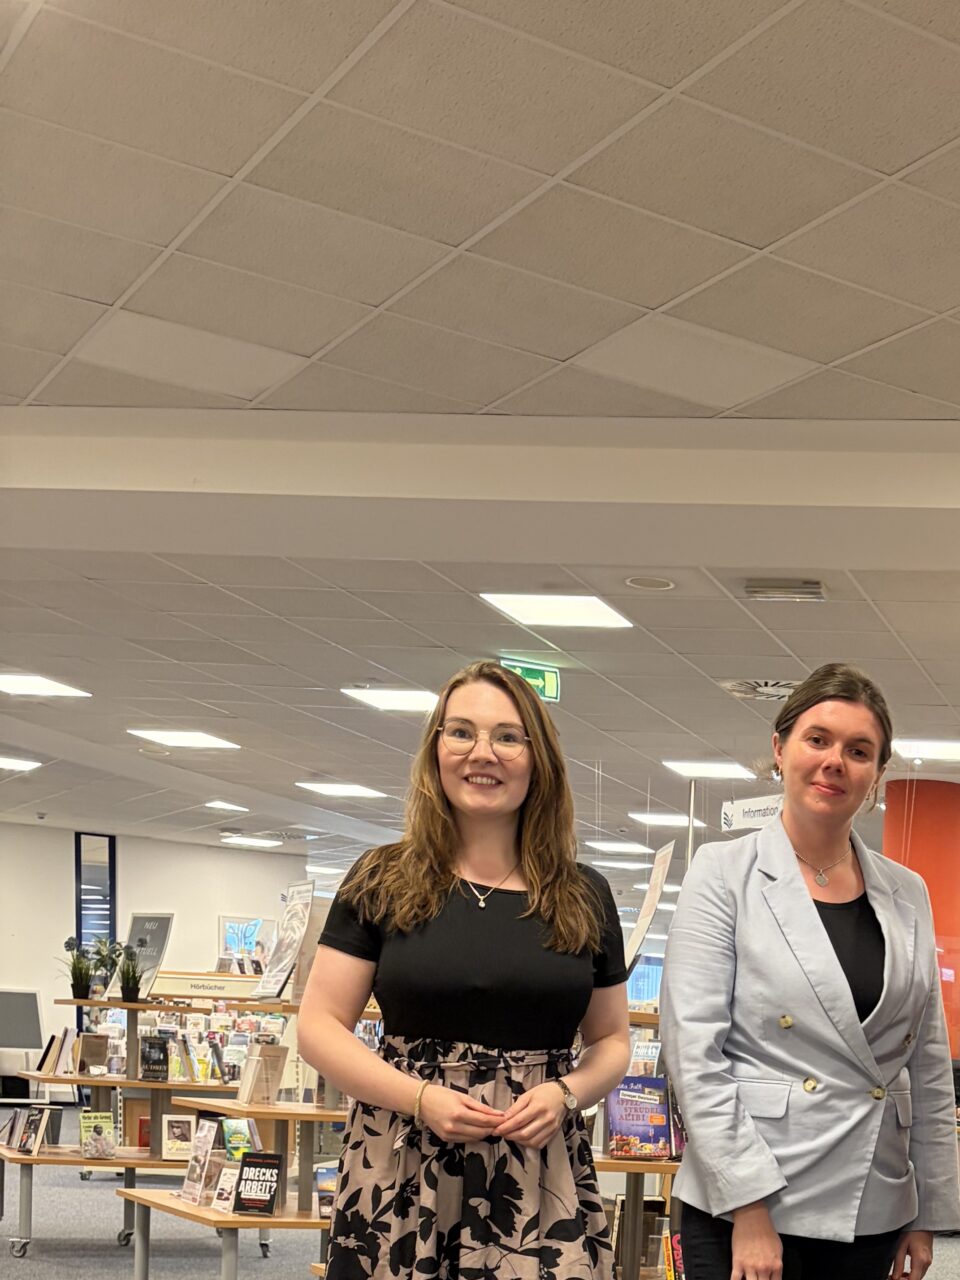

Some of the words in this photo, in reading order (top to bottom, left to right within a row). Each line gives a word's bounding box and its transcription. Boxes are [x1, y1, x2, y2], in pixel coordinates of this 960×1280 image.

[742, 806, 779, 819] Information
[190, 983, 225, 991] Hörbücher
[242, 1167, 279, 1182] DRECKS
[238, 1180, 278, 1195] ARBEIT?
